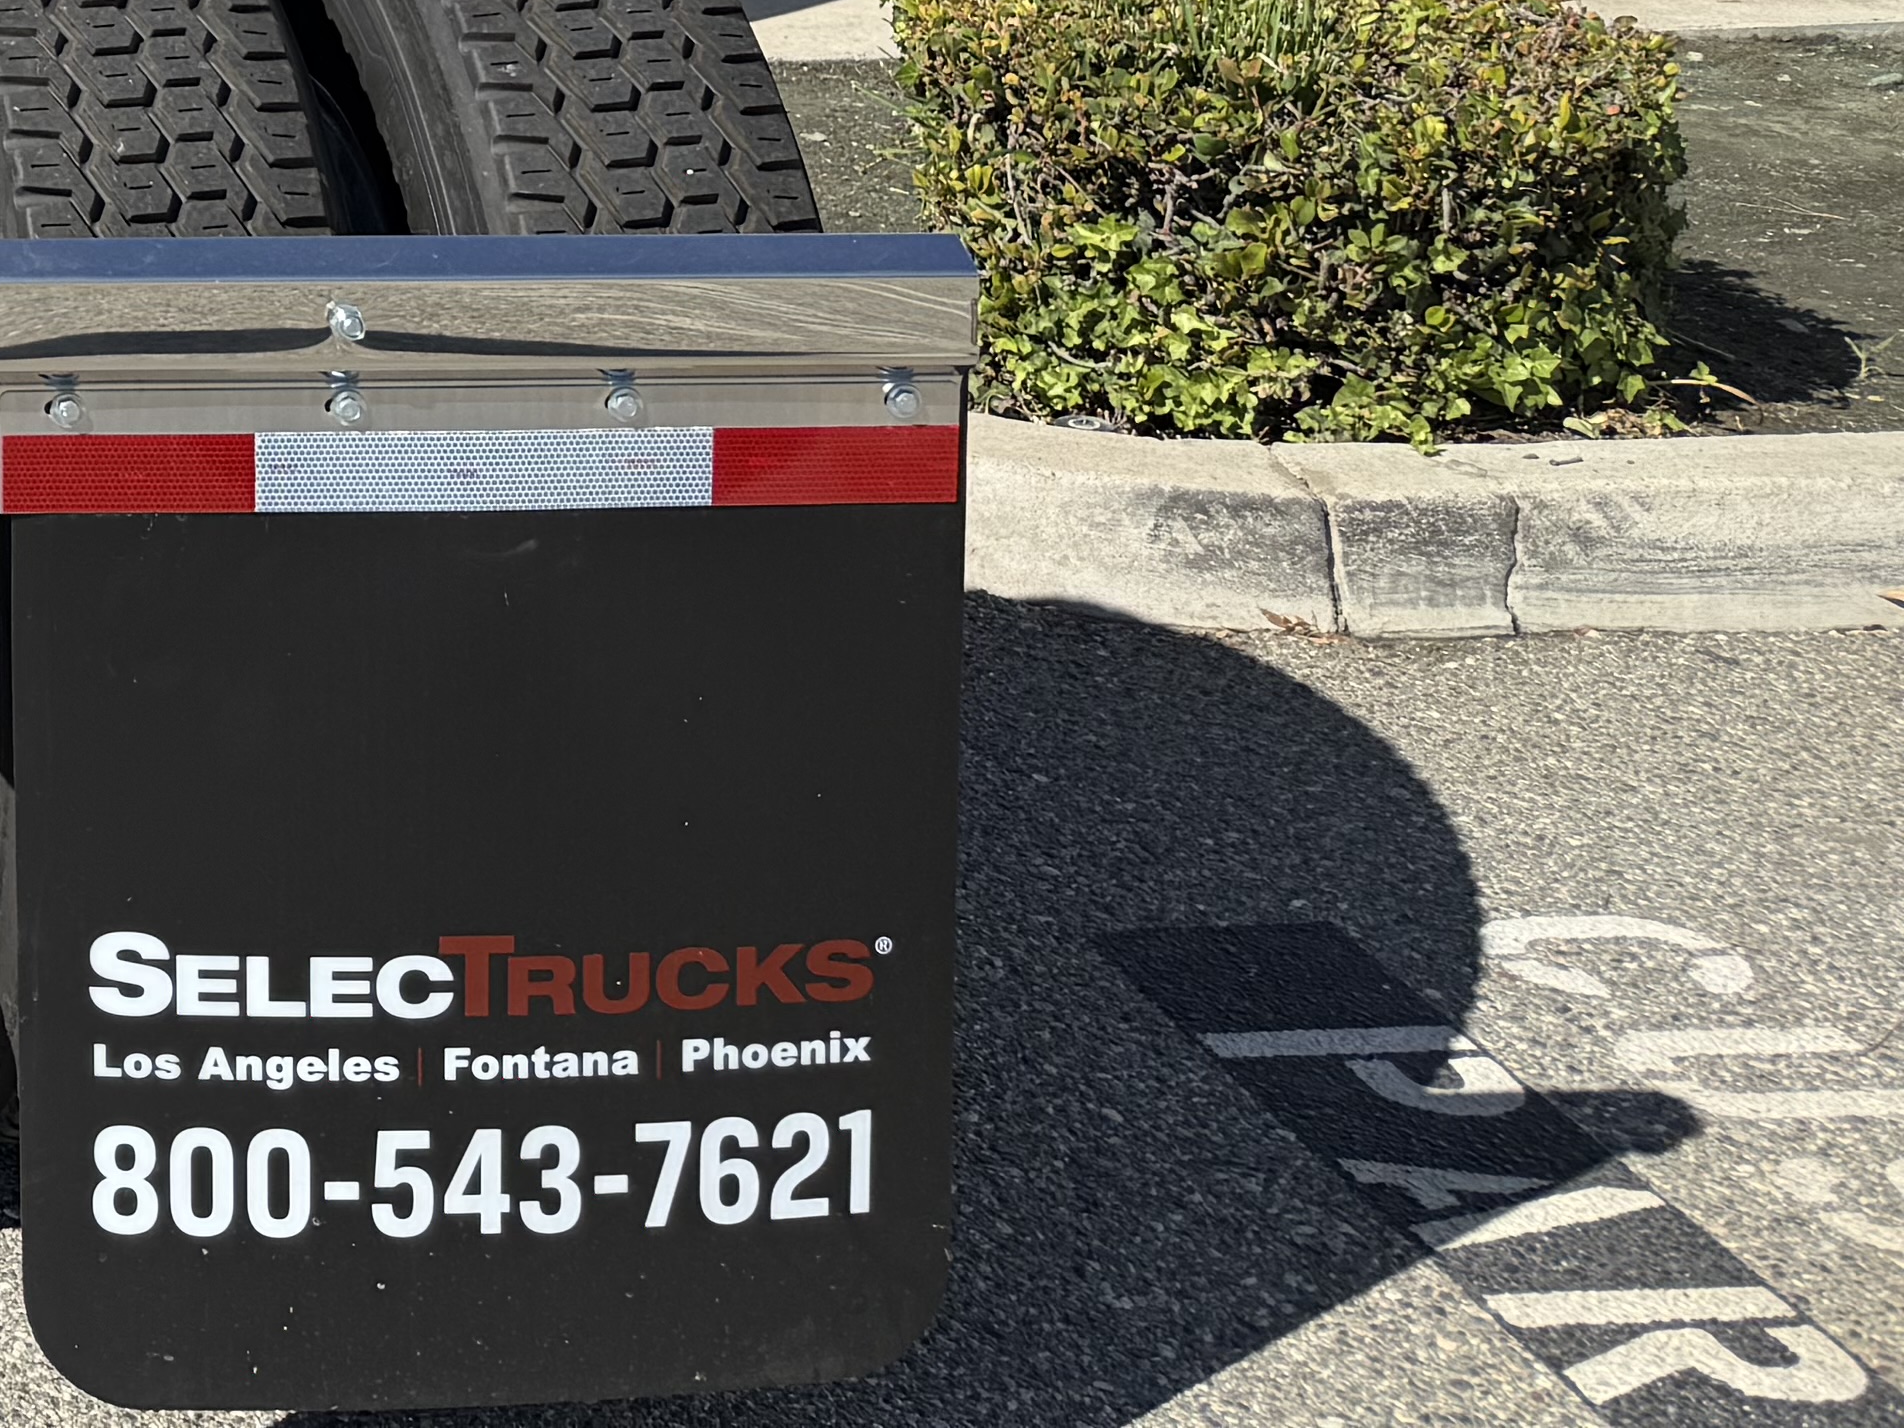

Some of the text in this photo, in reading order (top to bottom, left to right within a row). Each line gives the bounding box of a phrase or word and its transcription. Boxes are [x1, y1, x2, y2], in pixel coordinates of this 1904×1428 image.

[93, 1030, 872, 1091] Los Angeles Fontana Phoenix
[92, 1108, 873, 1239] 800-543-7621
